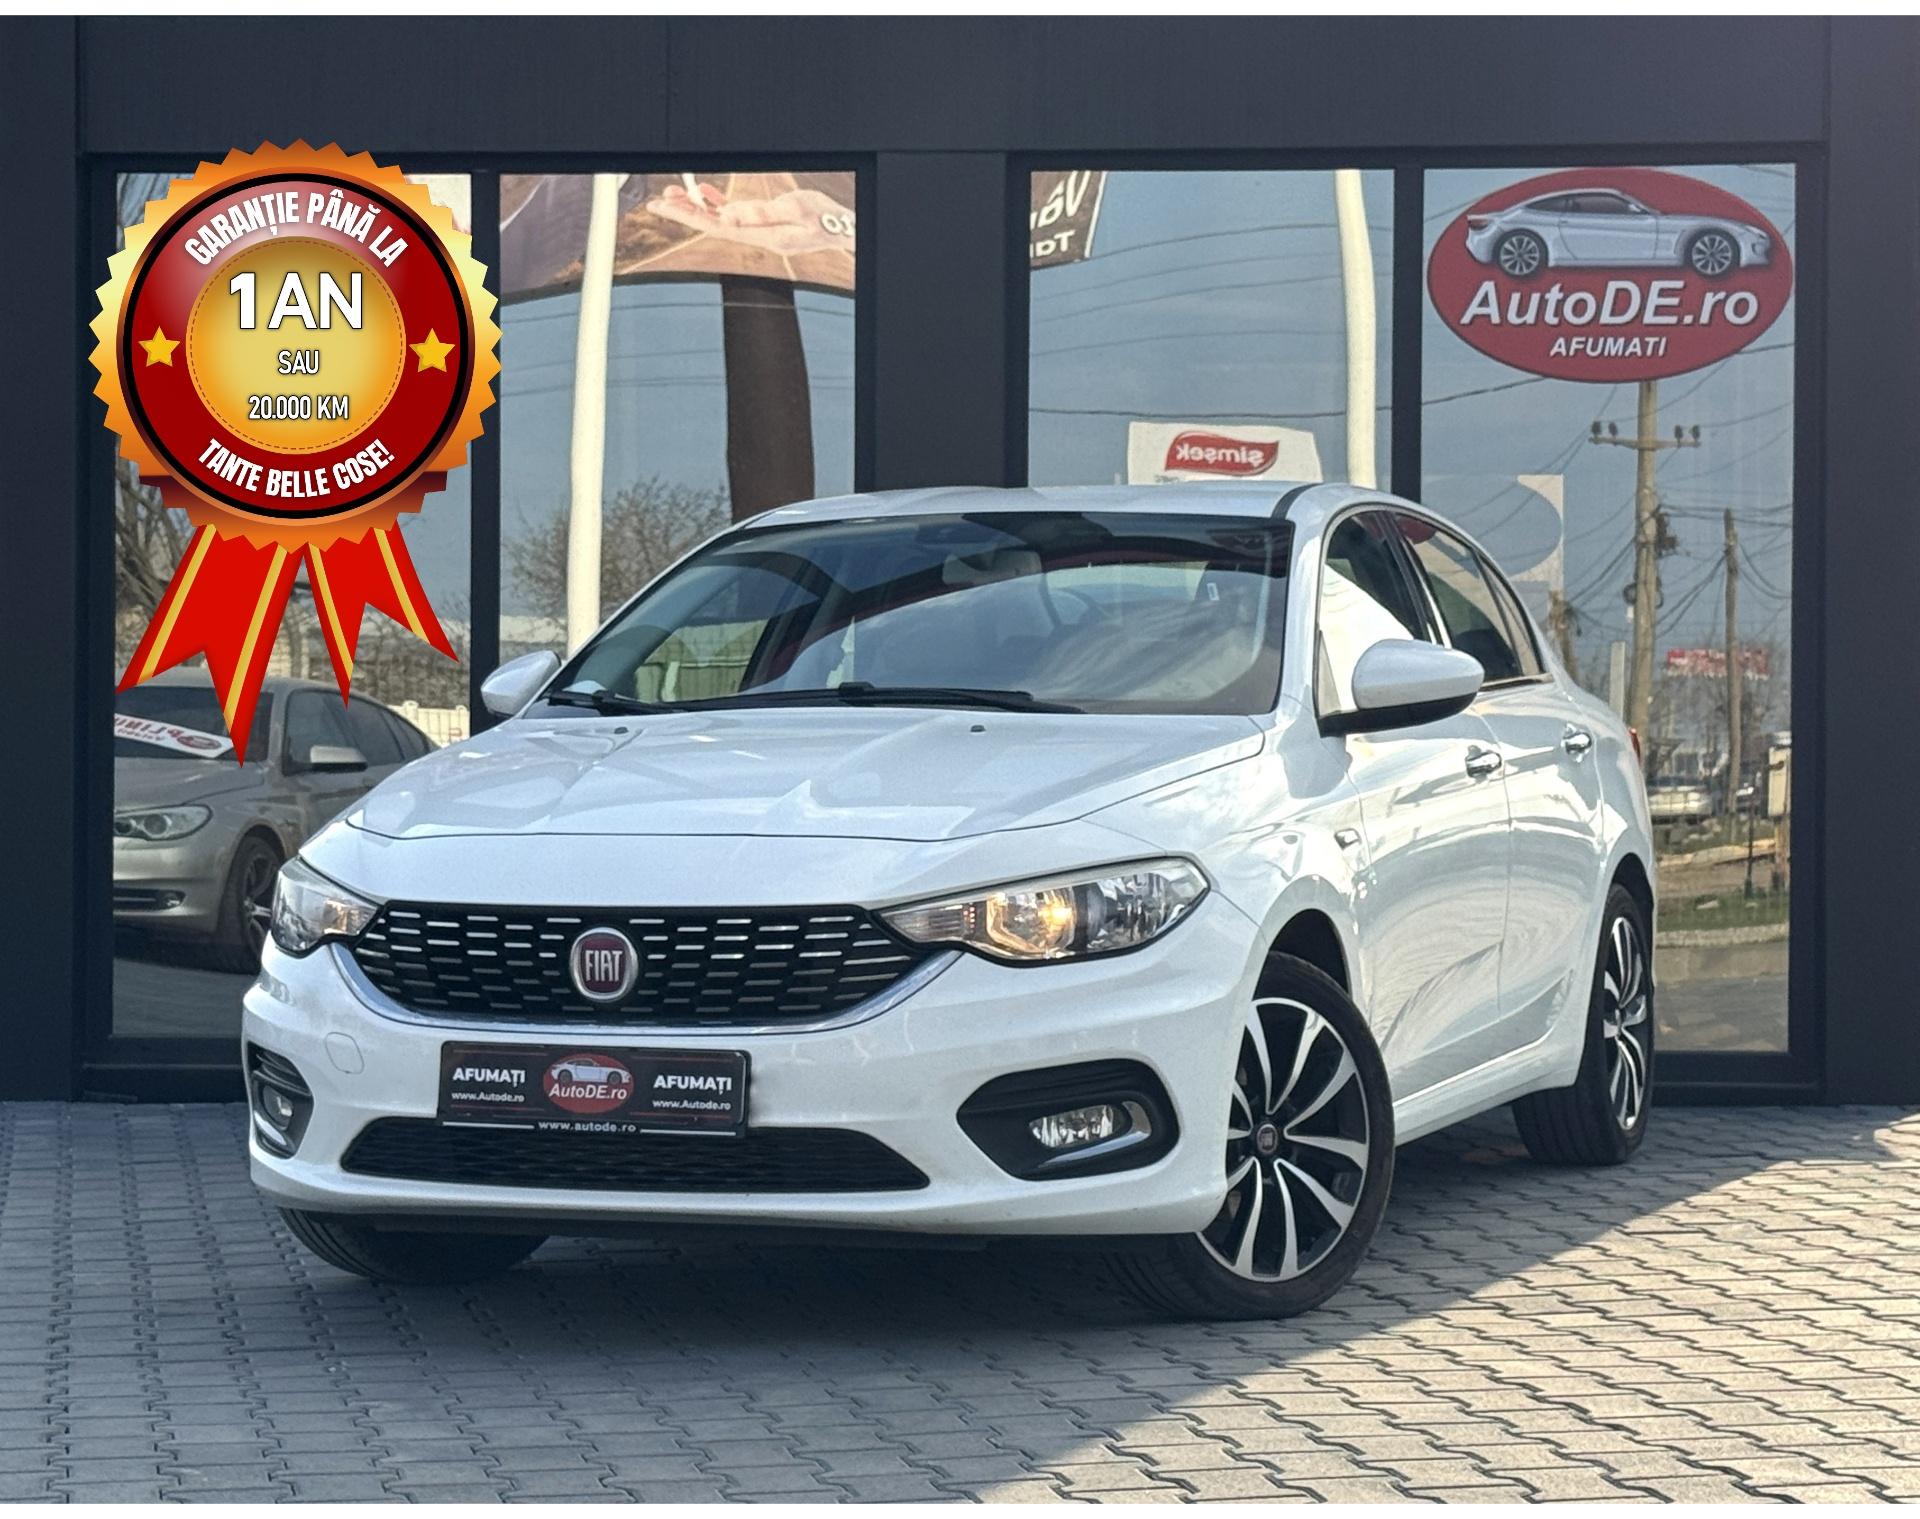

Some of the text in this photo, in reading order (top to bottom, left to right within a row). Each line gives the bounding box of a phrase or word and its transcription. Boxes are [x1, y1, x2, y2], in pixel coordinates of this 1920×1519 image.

[1460, 279, 1760, 327] AutoDE.ro
[1549, 336, 1667, 358] AFUMATI
[585, 949, 623, 982] FIAT
[452, 1067, 527, 1088] AFUMAȚI
[652, 1074, 733, 1095] AFUMAȚI
[451, 1091, 526, 1103] www.Autode.ro
[548, 1083, 628, 1100] AutoDE.ro
[652, 1099, 732, 1111] www.Autode.ro
[538, 1121, 637, 1133] www.autode.ro
